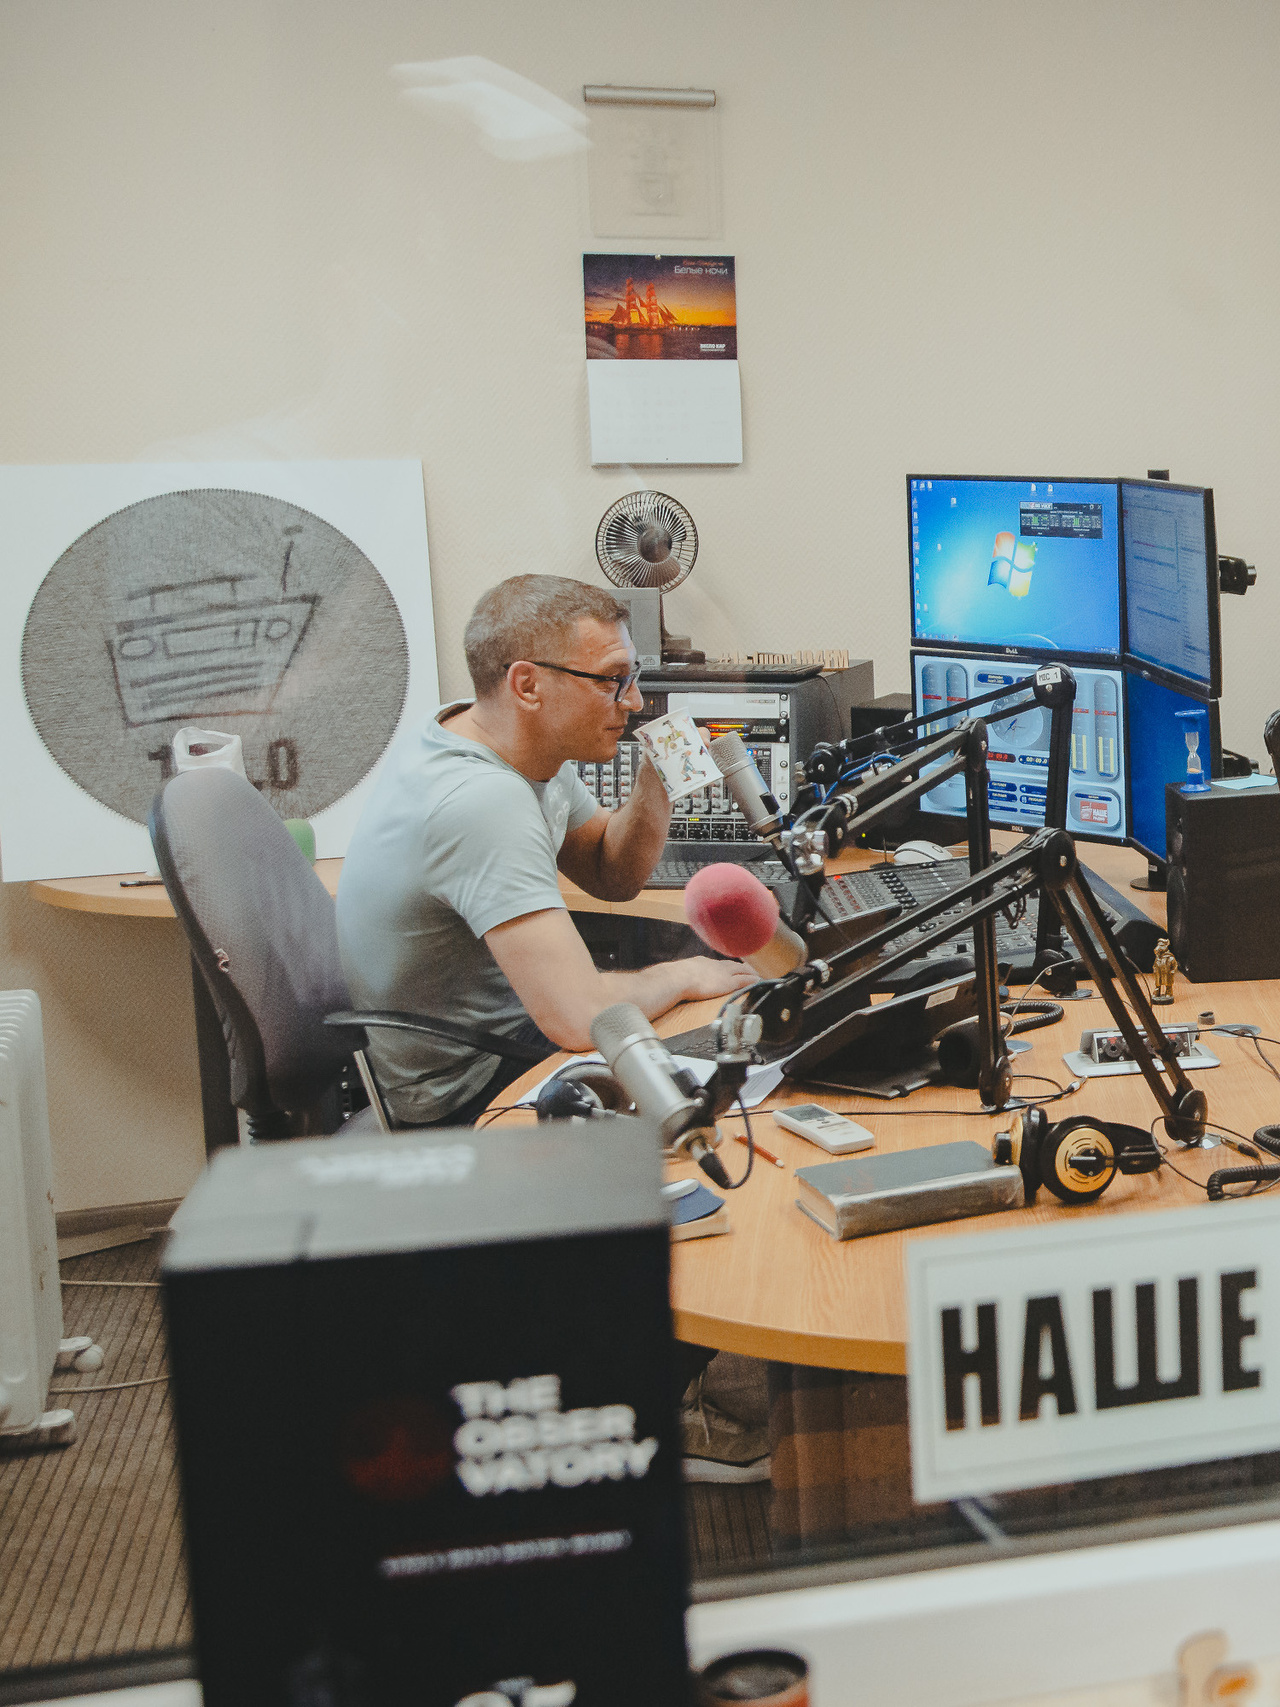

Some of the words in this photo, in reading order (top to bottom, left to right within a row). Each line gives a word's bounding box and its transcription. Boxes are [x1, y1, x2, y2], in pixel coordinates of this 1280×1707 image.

[674, 265, 703, 275] Белые
[705, 267, 728, 275] ночи
[1039, 673, 1051, 681] MIC
[941, 1268, 1261, 1432] НАШЕ
[450, 1374, 561, 1419] THE
[454, 1404, 637, 1459] OBSER
[456, 1436, 660, 1498] VATORY
